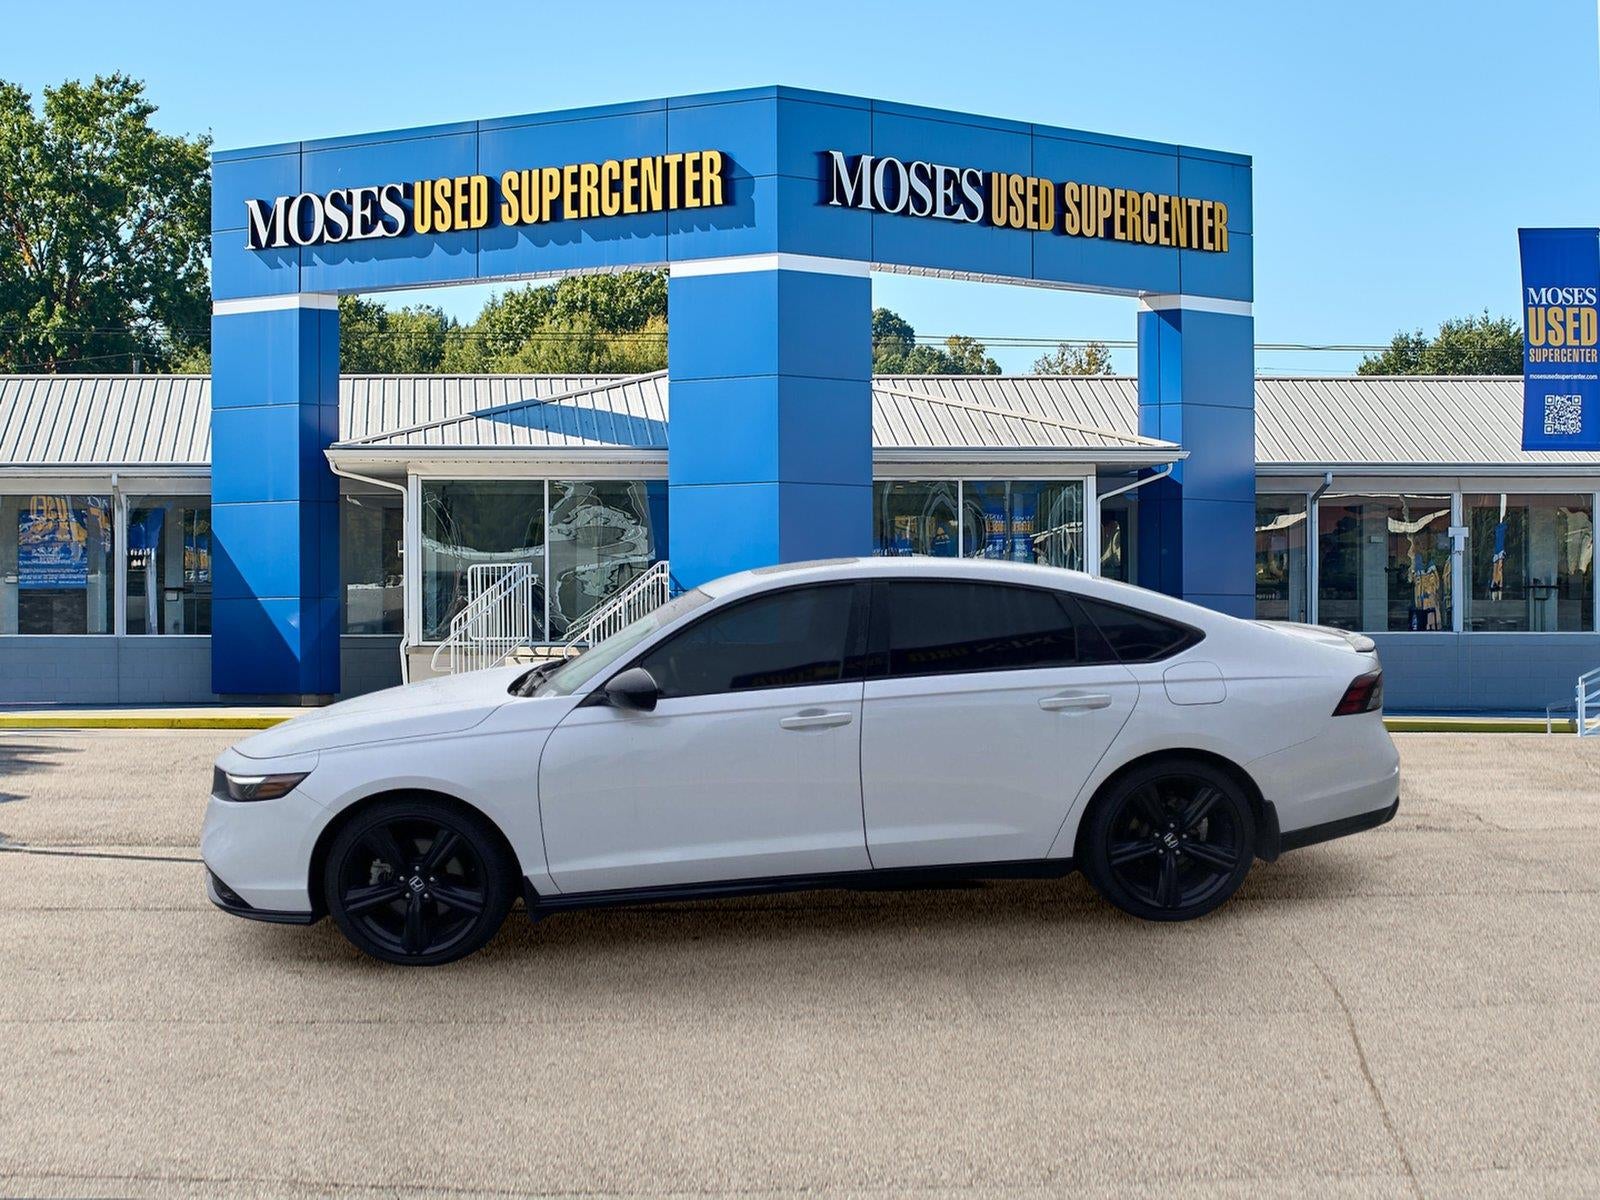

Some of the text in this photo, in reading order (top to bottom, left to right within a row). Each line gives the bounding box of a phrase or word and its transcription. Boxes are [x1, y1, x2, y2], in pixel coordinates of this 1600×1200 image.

[244, 149, 725, 250] MOSES USED SUPERCENTER
[828, 150, 1229, 253] MOSES USED SUPERCENTER
[1527, 287, 1597, 305] MOSES
[1528, 306, 1598, 347] USED
[1529, 348, 1598, 363] SUPERCENTER
[1529, 373, 1598, 381] mosesusedsupercenter.com
